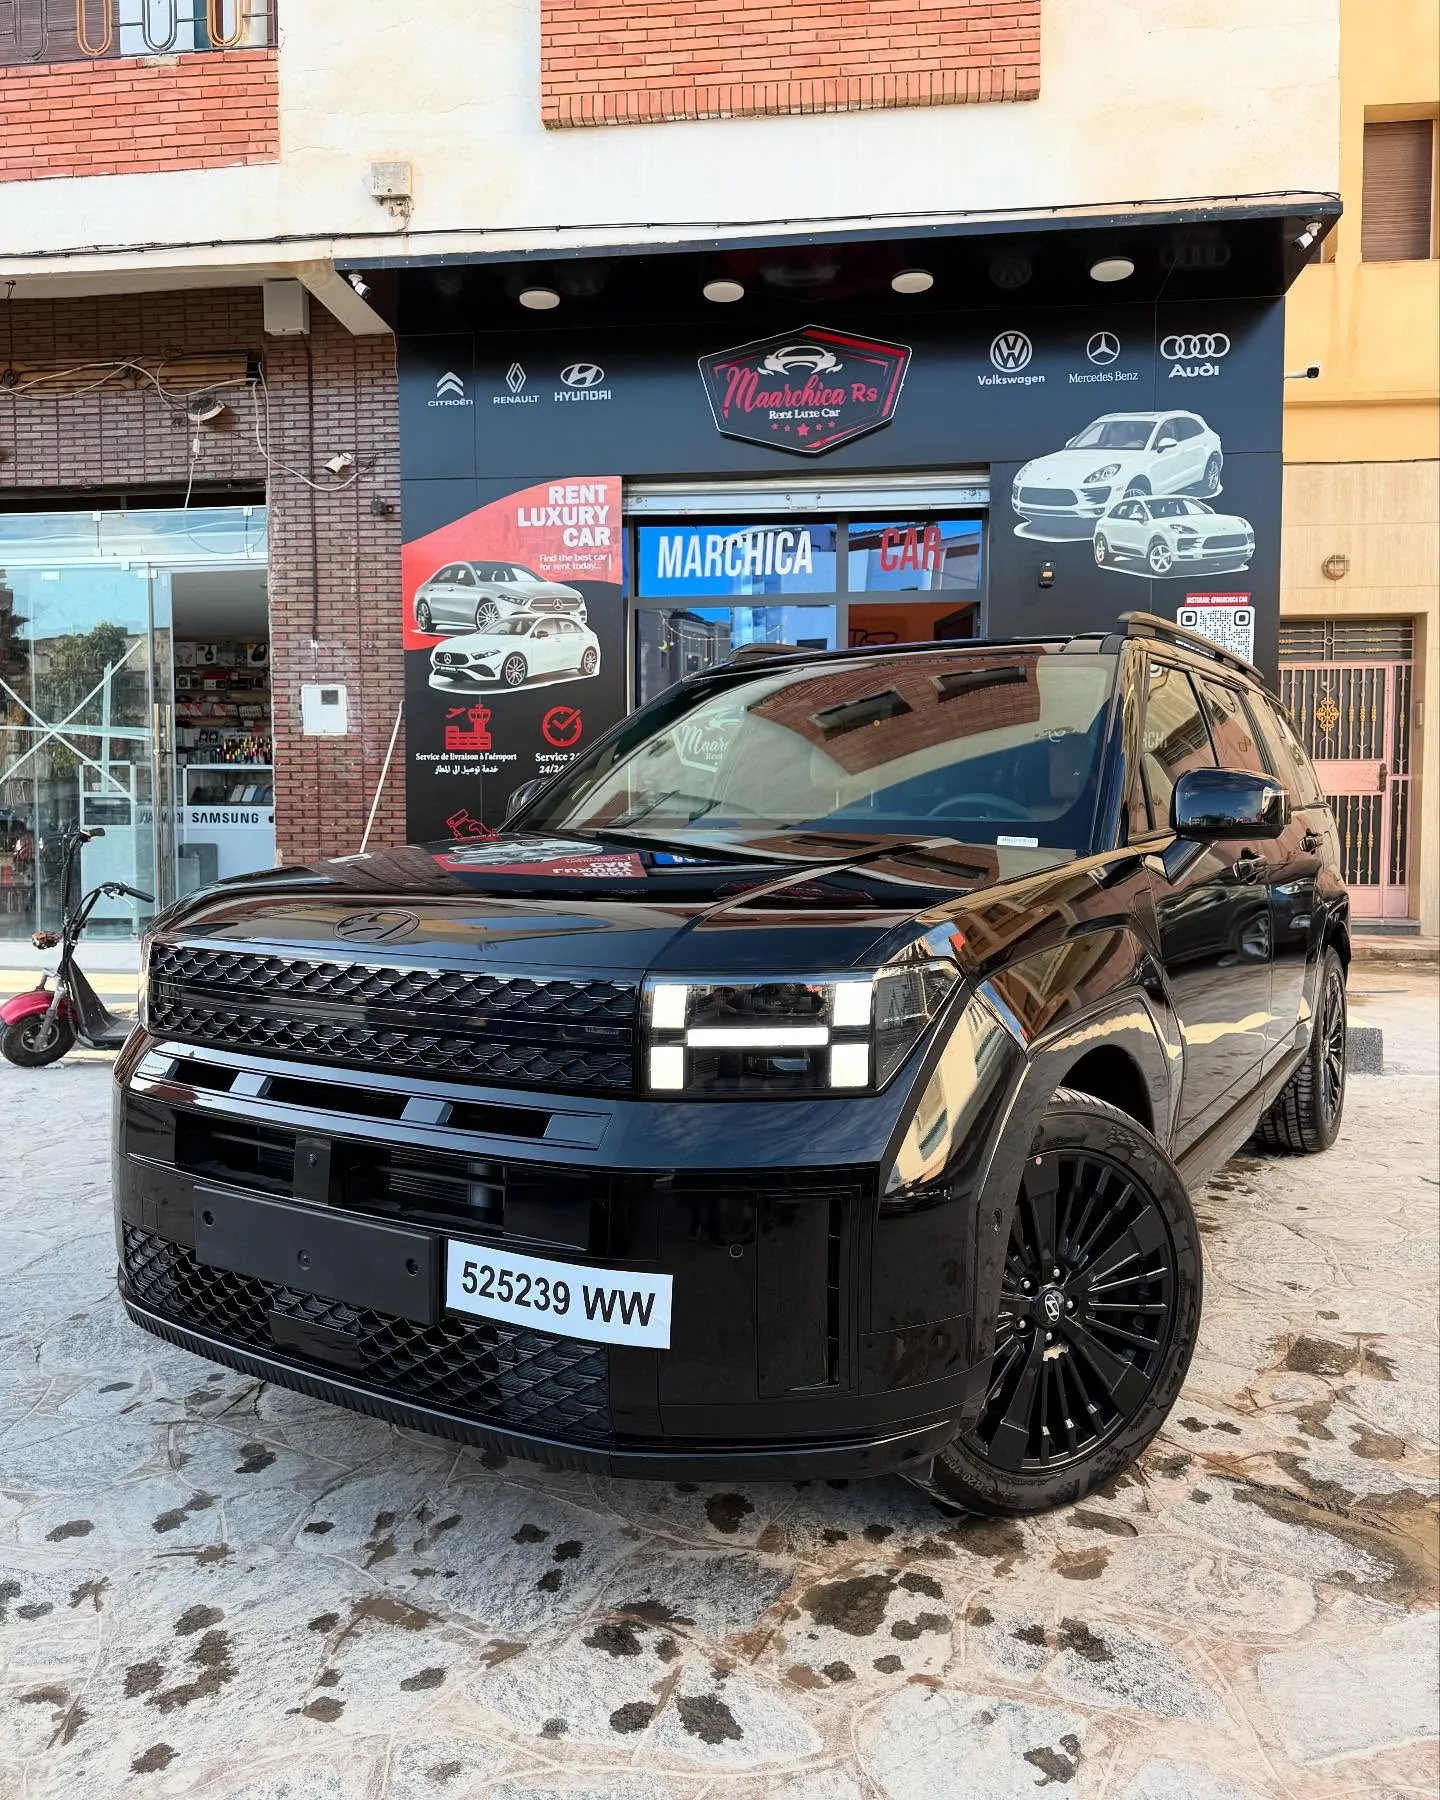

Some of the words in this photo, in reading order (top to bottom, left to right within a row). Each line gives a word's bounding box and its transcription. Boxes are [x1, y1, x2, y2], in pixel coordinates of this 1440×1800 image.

[1168, 363, 1220, 378] Audi
[977, 374, 1046, 386] Volkswagen
[1068, 372, 1114, 384] Mercedes
[1115, 371, 1139, 382] Benz
[554, 390, 612, 402] HYUNDAI
[727, 367, 847, 413] Maarchica
[851, 383, 878, 402] Rs
[493, 395, 539, 404] RENAULT
[769, 409, 794, 420] Rent
[794, 408, 820, 419] Luxe
[821, 408, 841, 418] Car
[549, 484, 608, 505] RENT
[517, 506, 610, 527] LUXURY
[562, 528, 611, 547] CAR
[657, 530, 814, 579] MARCHICA
[879, 525, 943, 573] CAR
[540, 554, 557, 562] Find
[574, 553, 592, 561] best
[540, 563, 551, 571] for
[553, 562, 570, 571] rent
[415, 752, 440, 761] Service
[440, 752, 449, 761] de
[449, 752, 479, 761] livraison
[479, 752, 485, 761] à
[484, 752, 517, 763] l'aéroport
[535, 752, 569, 762] Service
[191, 812, 259, 824] SAMSUNG
[462, 1260, 571, 1316] 525239
[582, 1284, 656, 1327] WW
